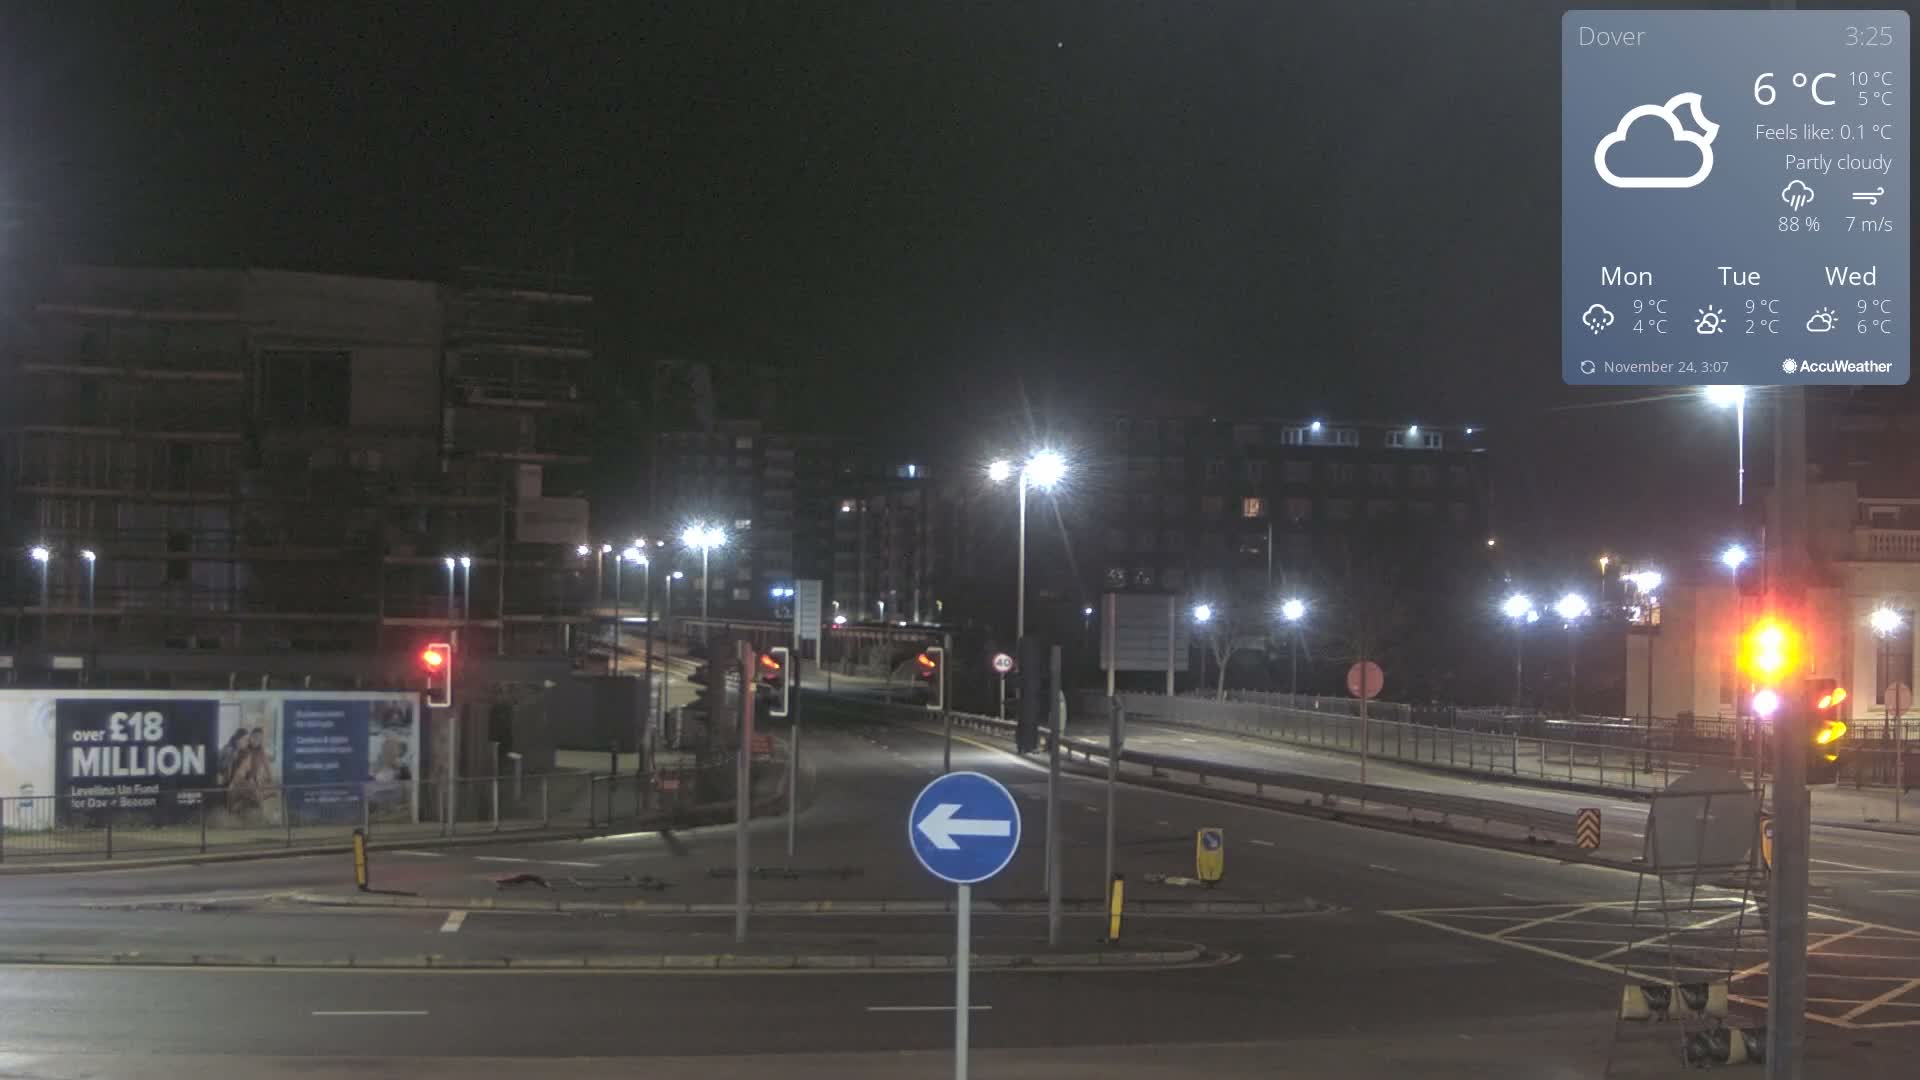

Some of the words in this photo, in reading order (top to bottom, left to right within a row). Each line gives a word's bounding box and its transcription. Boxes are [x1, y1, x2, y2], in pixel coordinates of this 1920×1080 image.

[72, 729, 105, 742] over
[110, 711, 164, 742] £18
[71, 745, 206, 777] MILLION
